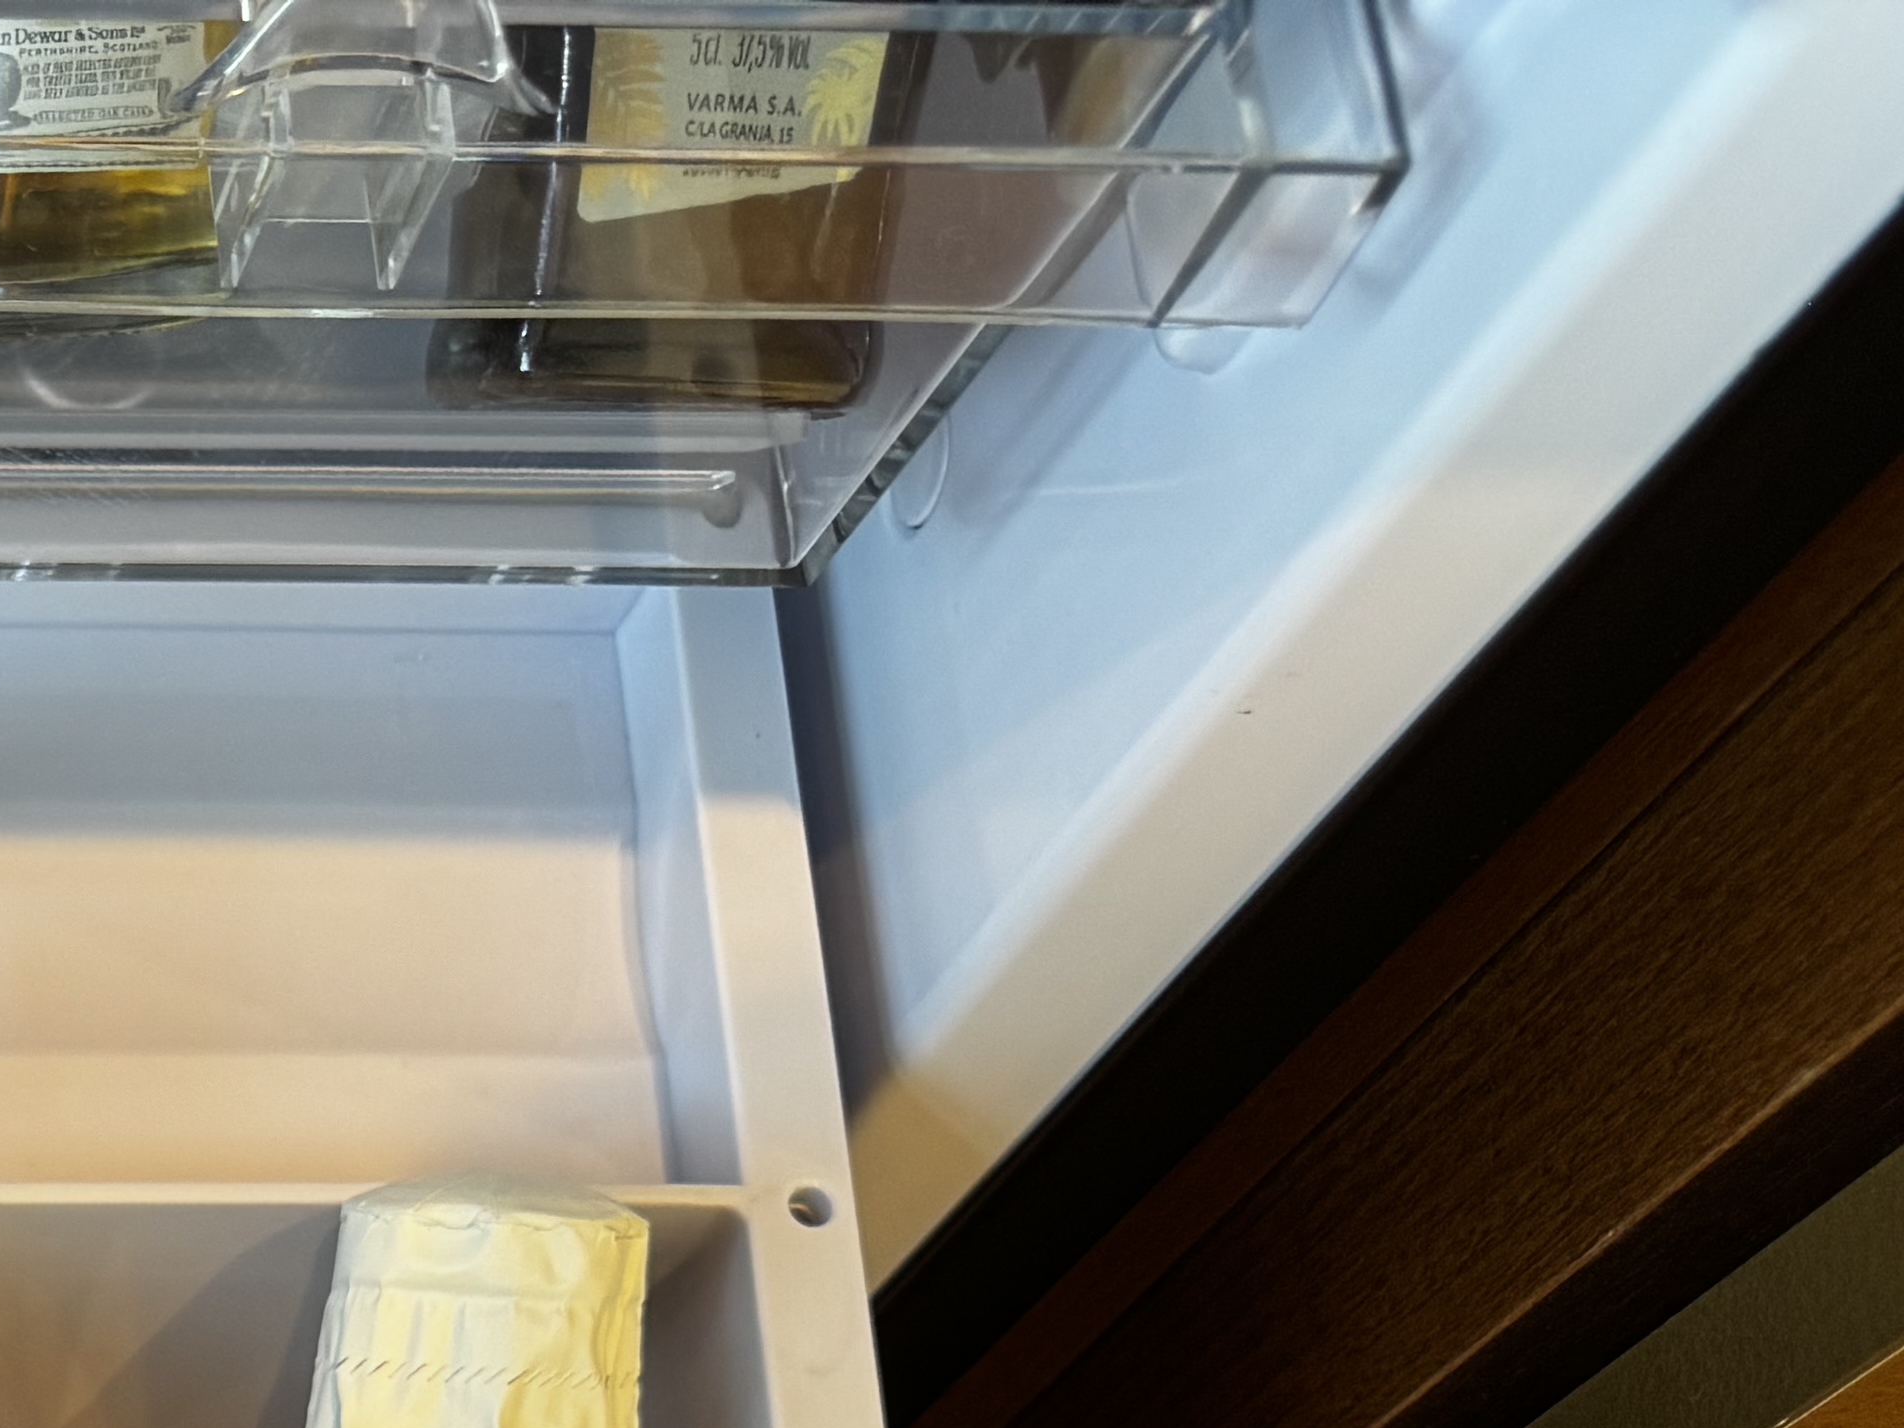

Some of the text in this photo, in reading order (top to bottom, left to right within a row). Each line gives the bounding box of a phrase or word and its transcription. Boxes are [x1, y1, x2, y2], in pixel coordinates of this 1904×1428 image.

[14, 27, 72, 45] Dewar
[74, 28, 86, 41] &
[87, 26, 128, 40] Sons
[686, 91, 803, 117] VARMA S.A.
